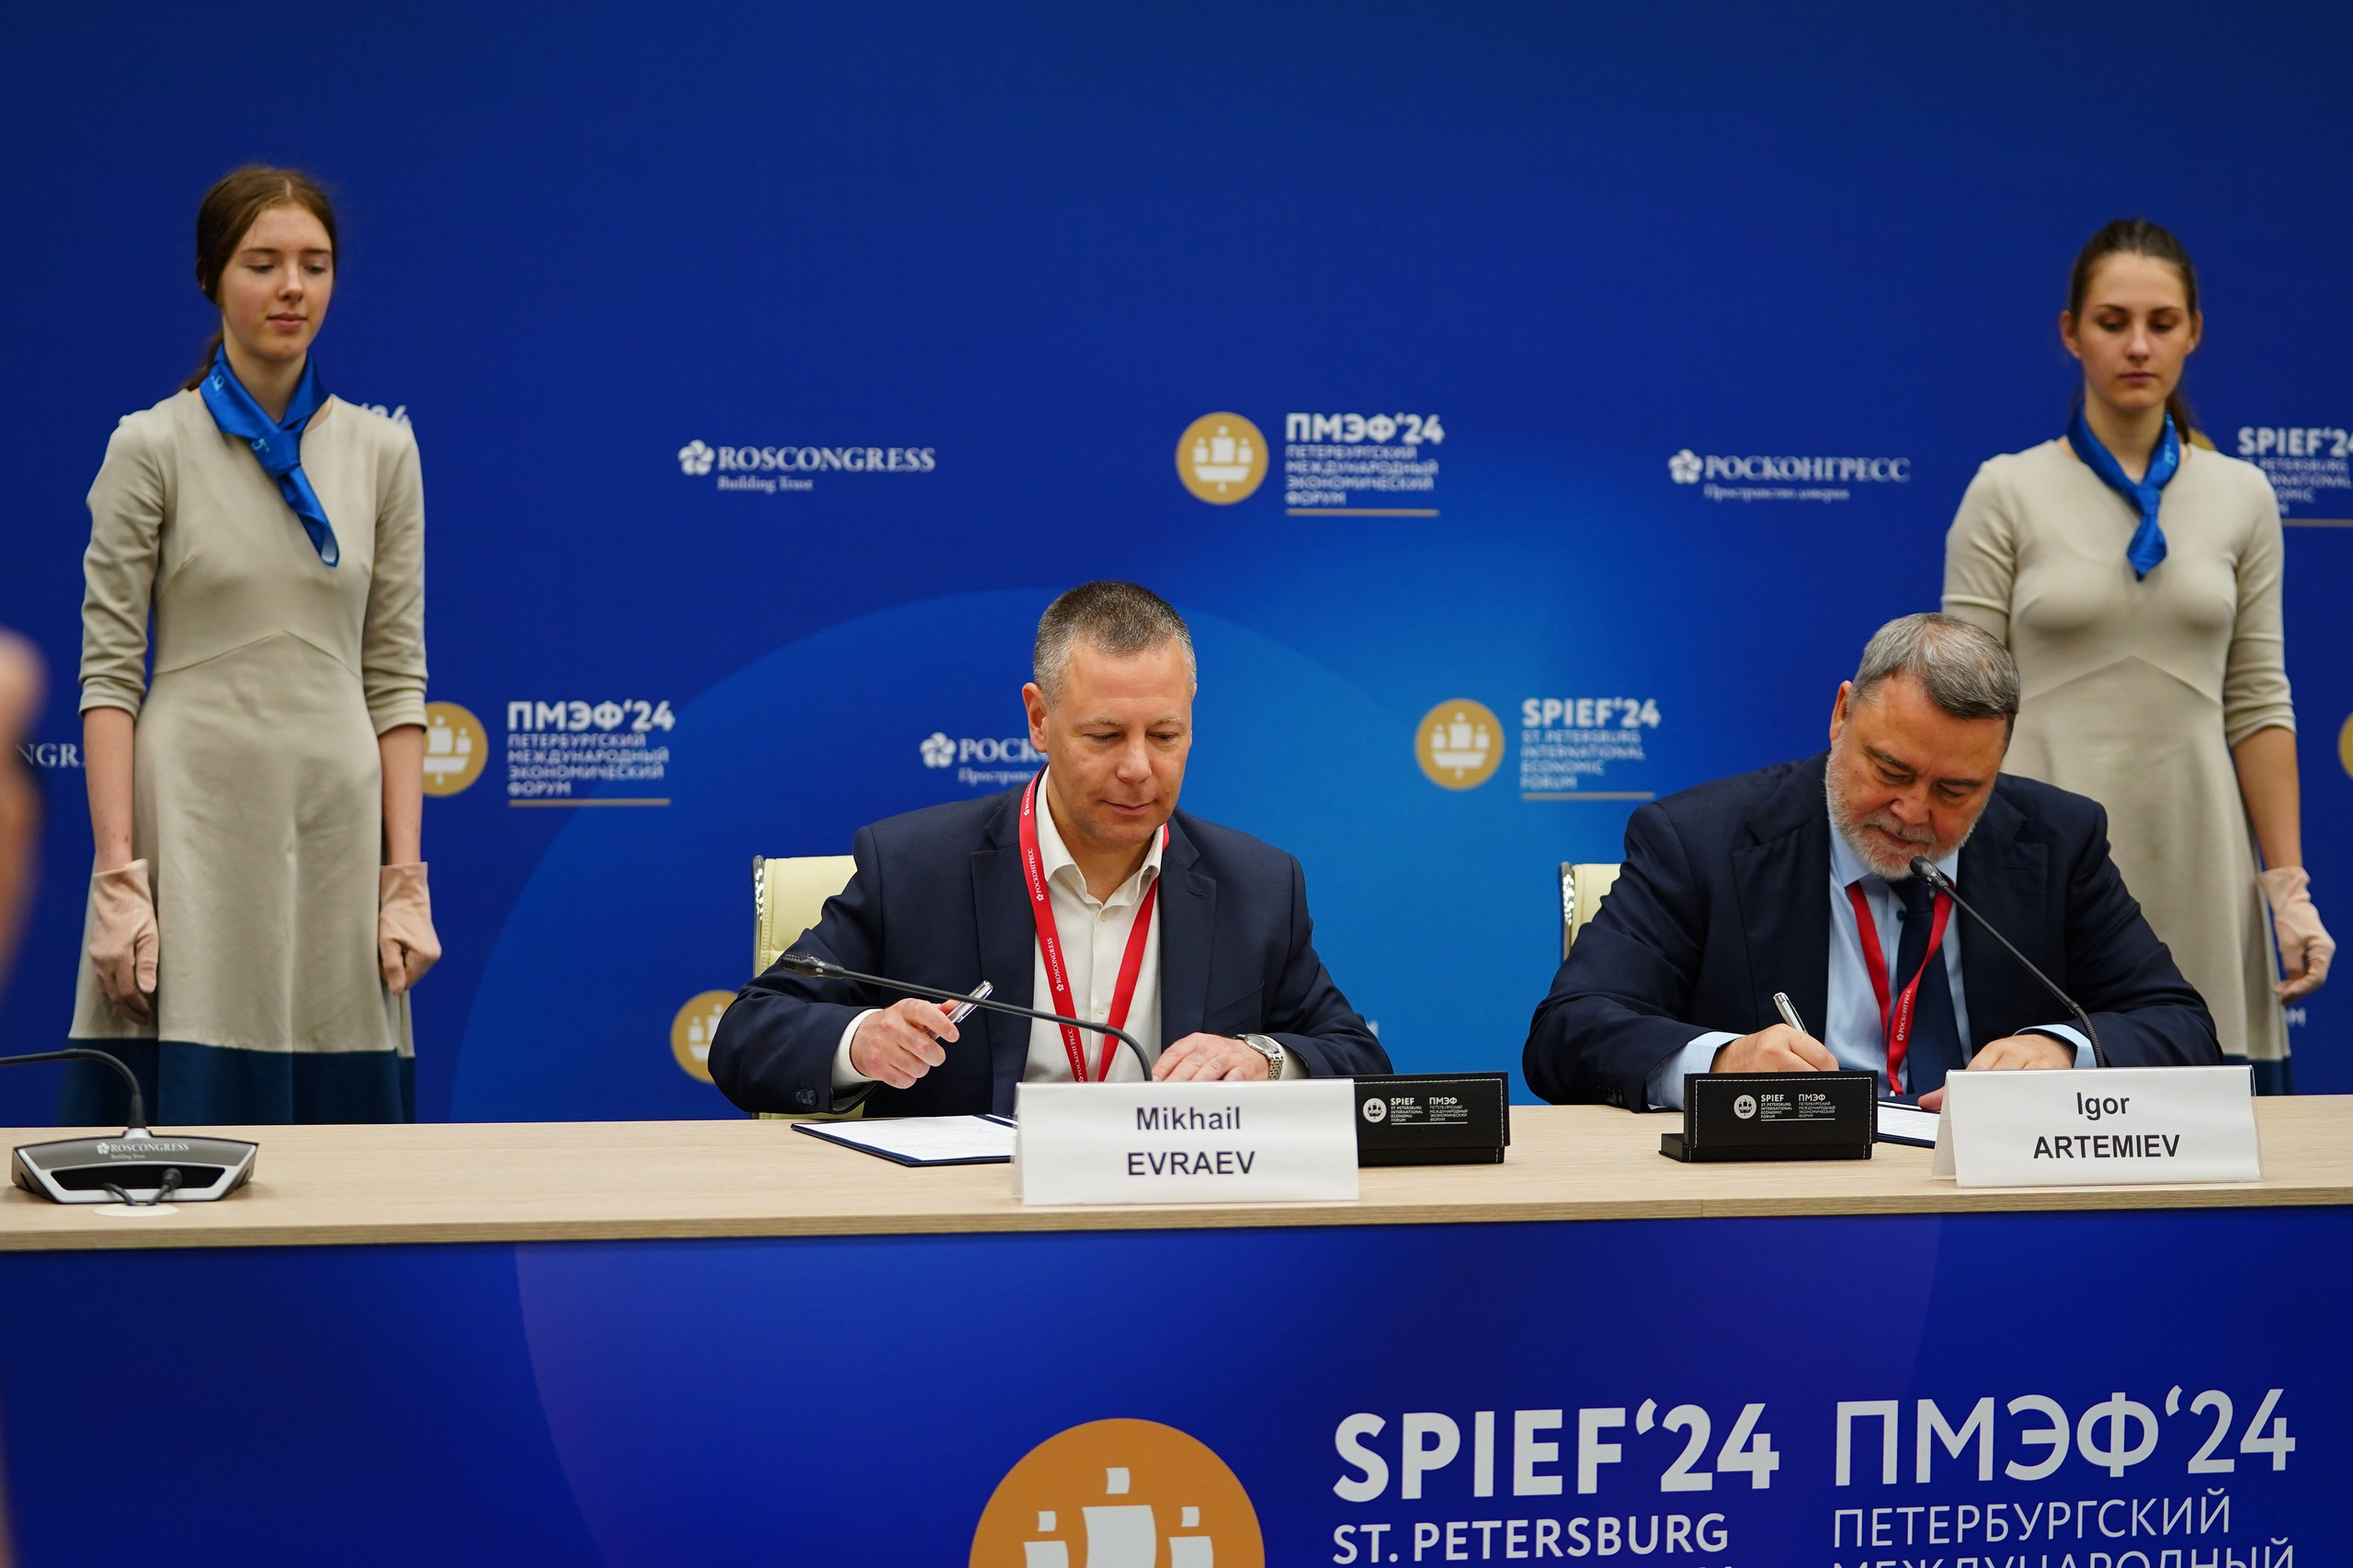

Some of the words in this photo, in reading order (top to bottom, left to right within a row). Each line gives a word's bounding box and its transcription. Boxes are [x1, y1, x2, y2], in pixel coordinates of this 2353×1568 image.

[718, 446, 936, 472] ROSCONGRESS
[1705, 455, 1911, 483] РОСКОНГРЕСС
[1028, 848, 1042, 893] РОСКОНГРЕСС
[1047, 937, 1062, 983] ROSCONGRESS
[1391, 1097, 1415, 1106] SPIEF
[1429, 1096, 1458, 1105] ПМЭФ
[1761, 1094, 1784, 1102] SPIEF
[1799, 1094, 1825, 1102] ПМЭФ
[2076, 1092, 2130, 1120] Igor
[1136, 1107, 1241, 1131] Mikhail
[111, 1142, 189, 1153] ROSCONGRESS
[2033, 1134, 2180, 1159] ARTEMIEV
[1127, 1151, 1256, 1176] EVRAEV
[1836, 1384, 2296, 1486] ПМЭФ‘24
[1333, 1397, 1779, 1503] SPIEF‘24
[1835, 1487, 2230, 1548] ПЕТЕРБУРГСКИЙ
[1333, 1524, 1399, 1564] ST.
[1414, 1513, 1728, 1562] PETERSBURG
